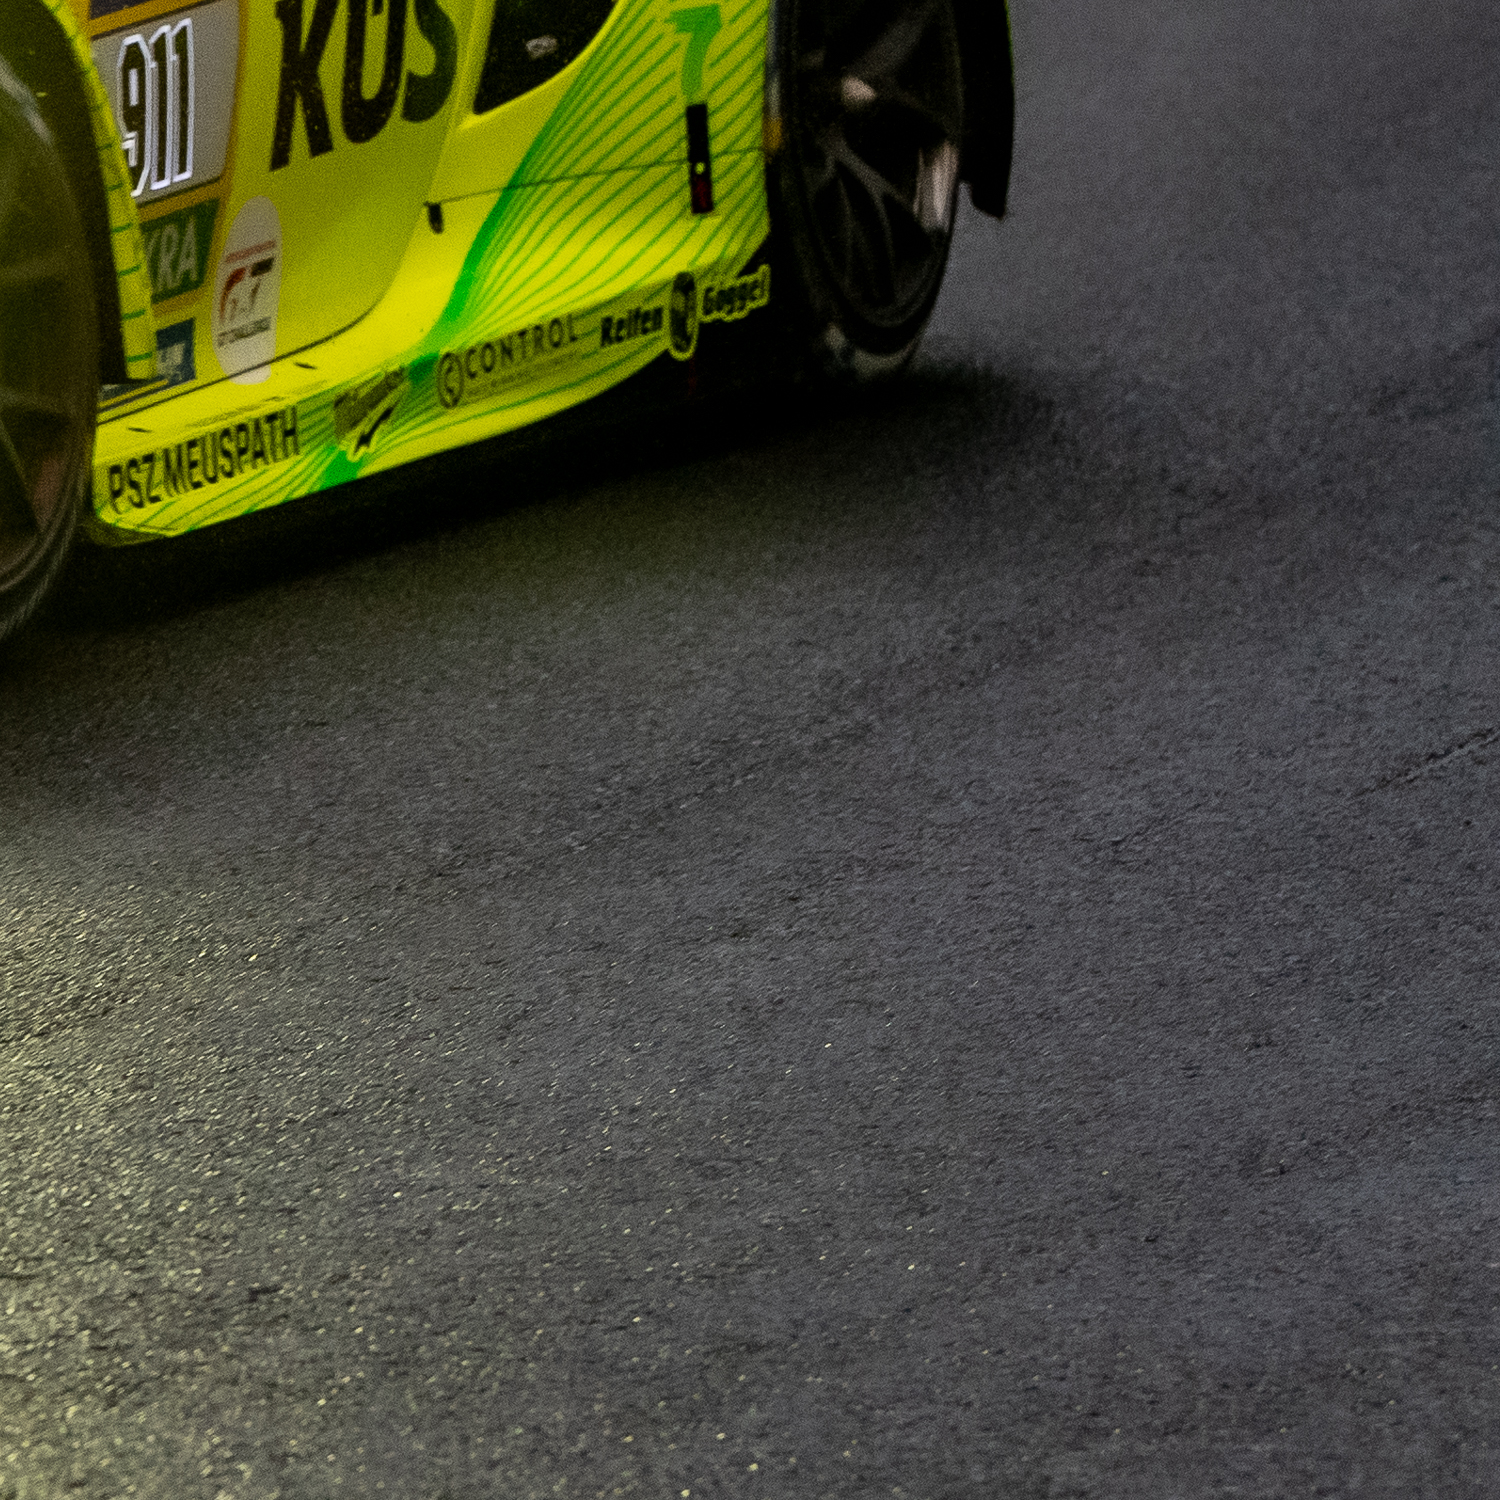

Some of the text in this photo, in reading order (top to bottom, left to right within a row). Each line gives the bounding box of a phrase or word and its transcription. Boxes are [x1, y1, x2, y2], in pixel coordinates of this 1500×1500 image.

[117, 17, 196, 198] 911
[464, 313, 579, 380] CONTROL
[108, 452, 162, 515] PSZ
[163, 403, 300, 497] MEUSPATH
